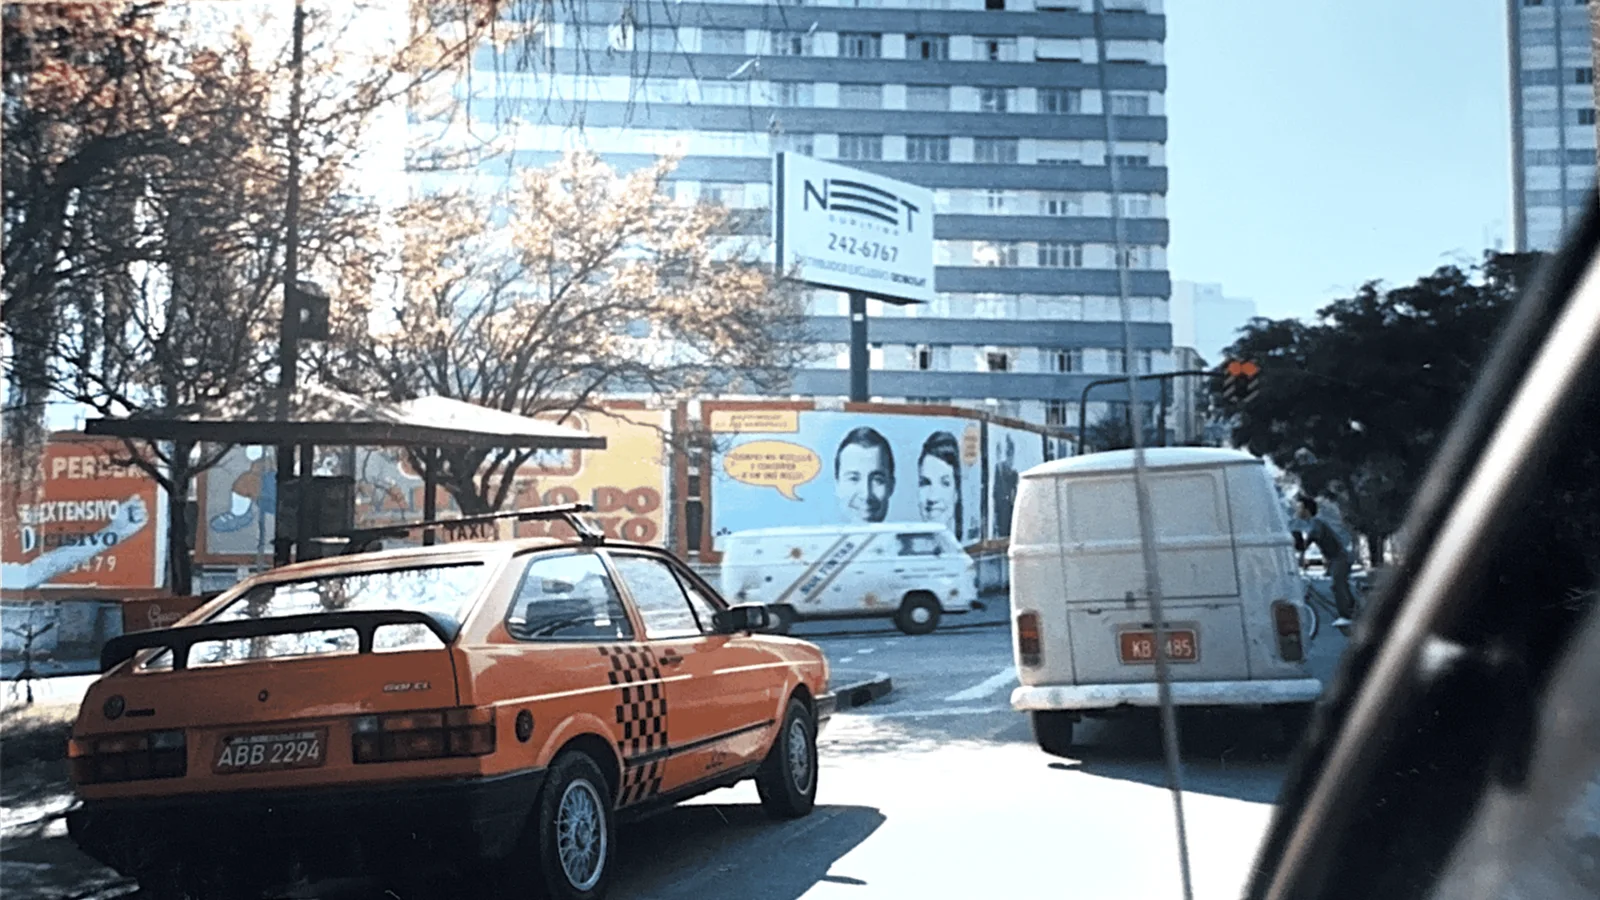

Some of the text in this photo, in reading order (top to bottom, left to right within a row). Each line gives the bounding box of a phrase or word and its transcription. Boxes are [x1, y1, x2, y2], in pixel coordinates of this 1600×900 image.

[827, 232, 899, 263] 242-6767
[591, 486, 661, 515] DO
[449, 521, 486, 541] TAXI
[1132, 640, 1152, 658] KB
[217, 739, 319, 767] ABB 2294
